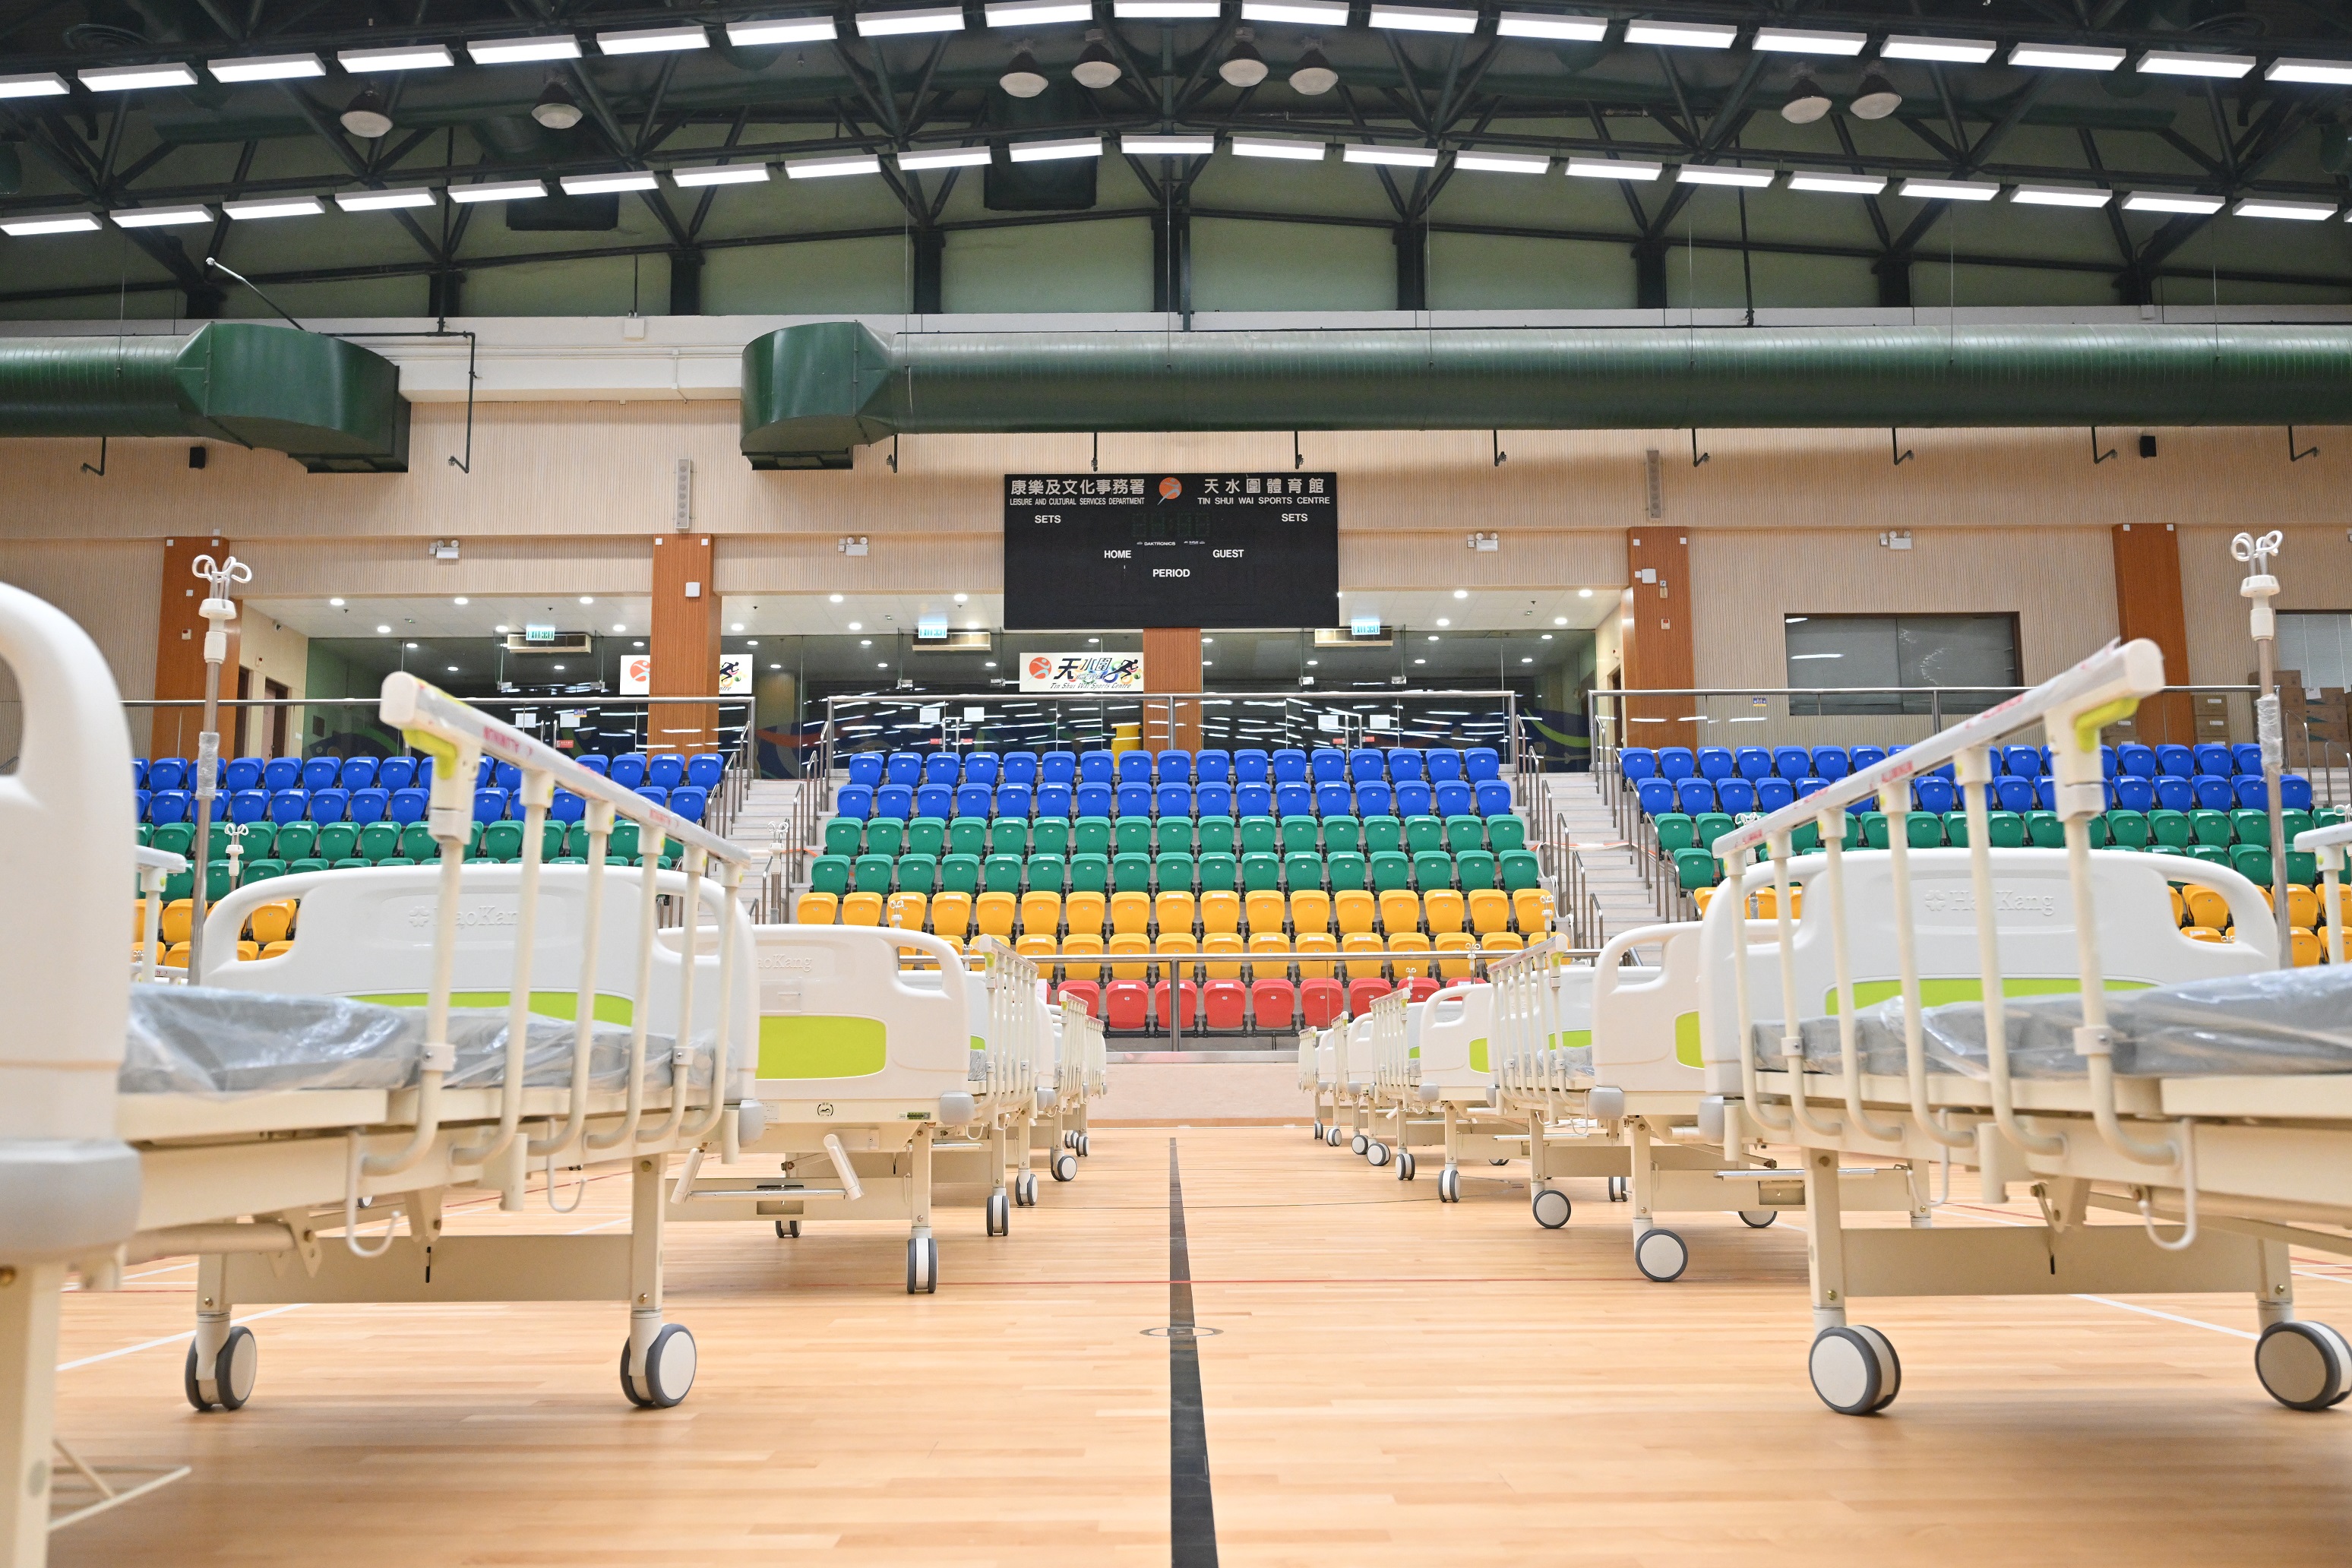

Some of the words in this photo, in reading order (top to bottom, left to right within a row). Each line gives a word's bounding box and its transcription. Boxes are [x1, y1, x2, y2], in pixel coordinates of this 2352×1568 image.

[1010, 479, 1145, 495] 康樂及文化事務署
[1204, 478, 1324, 494] 天水圍體育館
[1010, 498, 1032, 506] LEISURE
[1035, 498, 1046, 506] AND
[1108, 497, 1145, 505] DEPARTMENT
[1035, 515, 1061, 523] SETS
[1282, 513, 1308, 522] SETS
[1104, 550, 1132, 558] HOME
[1212, 549, 1244, 558] GUEST
[1152, 568, 1190, 577] PERIOD
[1949, 890, 2054, 916] HKang
